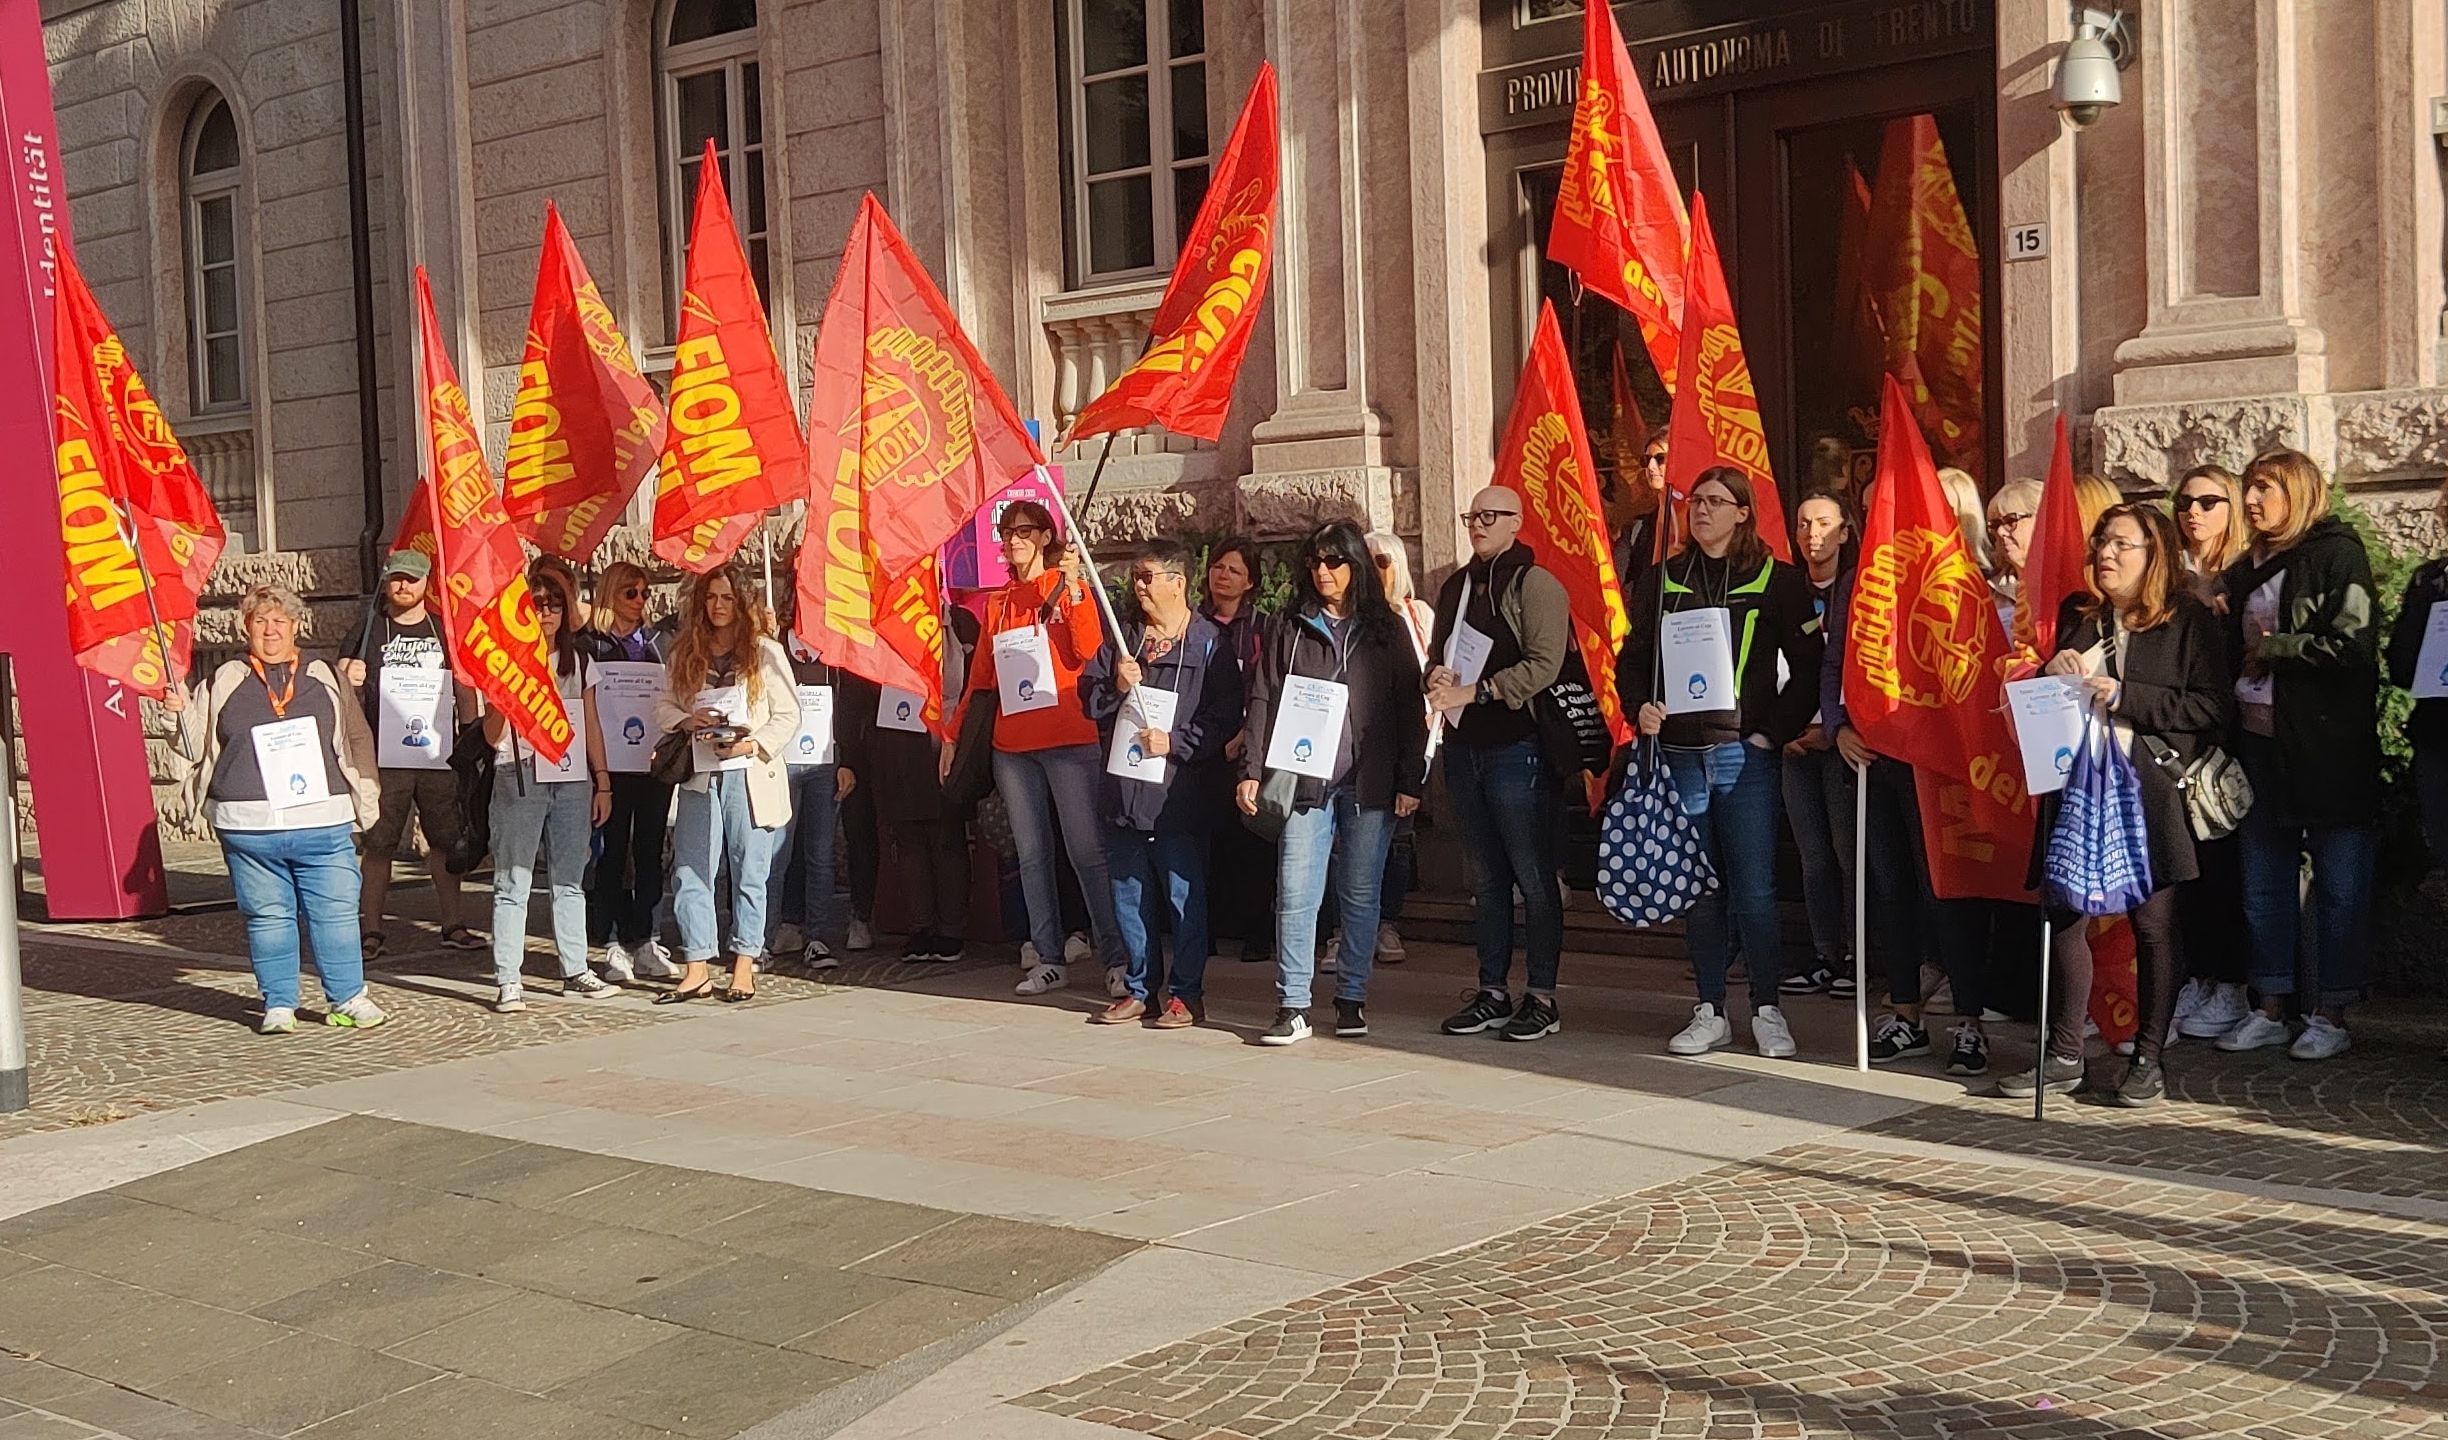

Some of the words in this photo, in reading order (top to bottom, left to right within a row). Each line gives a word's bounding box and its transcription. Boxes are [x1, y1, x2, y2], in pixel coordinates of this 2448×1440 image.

[1655, 28, 1791, 87] AUTONOMA
[1819, 20, 1846, 58] DI
[1874, 3, 1975, 46] TRENTO
[2015, 229, 2040, 252] 15
[508, 360, 577, 499] FIOM
[670, 334, 762, 497] FIOM
[57, 438, 157, 611] FIOM
[465, 617, 570, 744] Trentino
[1969, 750, 2029, 815] del
